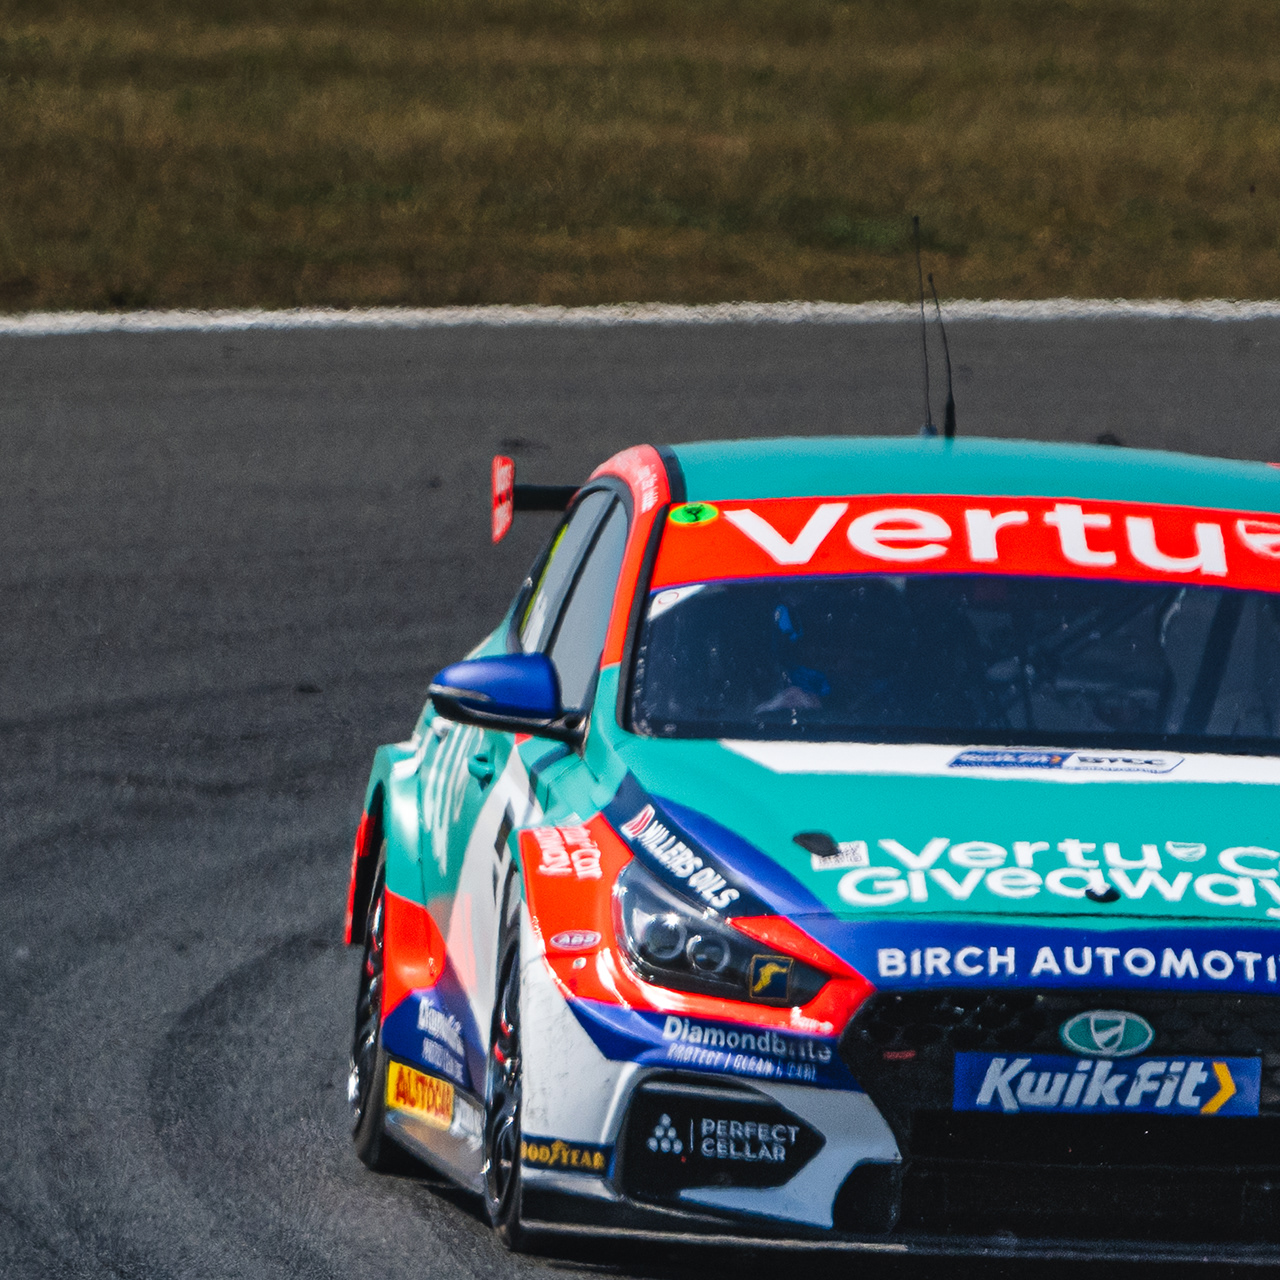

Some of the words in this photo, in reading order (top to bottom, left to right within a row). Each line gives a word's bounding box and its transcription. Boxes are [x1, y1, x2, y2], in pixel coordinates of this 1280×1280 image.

[638, 820, 703, 879] MILLERS
[688, 866, 740, 909] OILS
[876, 945, 1017, 979] BIRCH
[701, 1117, 800, 1144] PERFECT
[520, 1140, 606, 1170] OODYEAR
[701, 1137, 786, 1162] CELLAR
